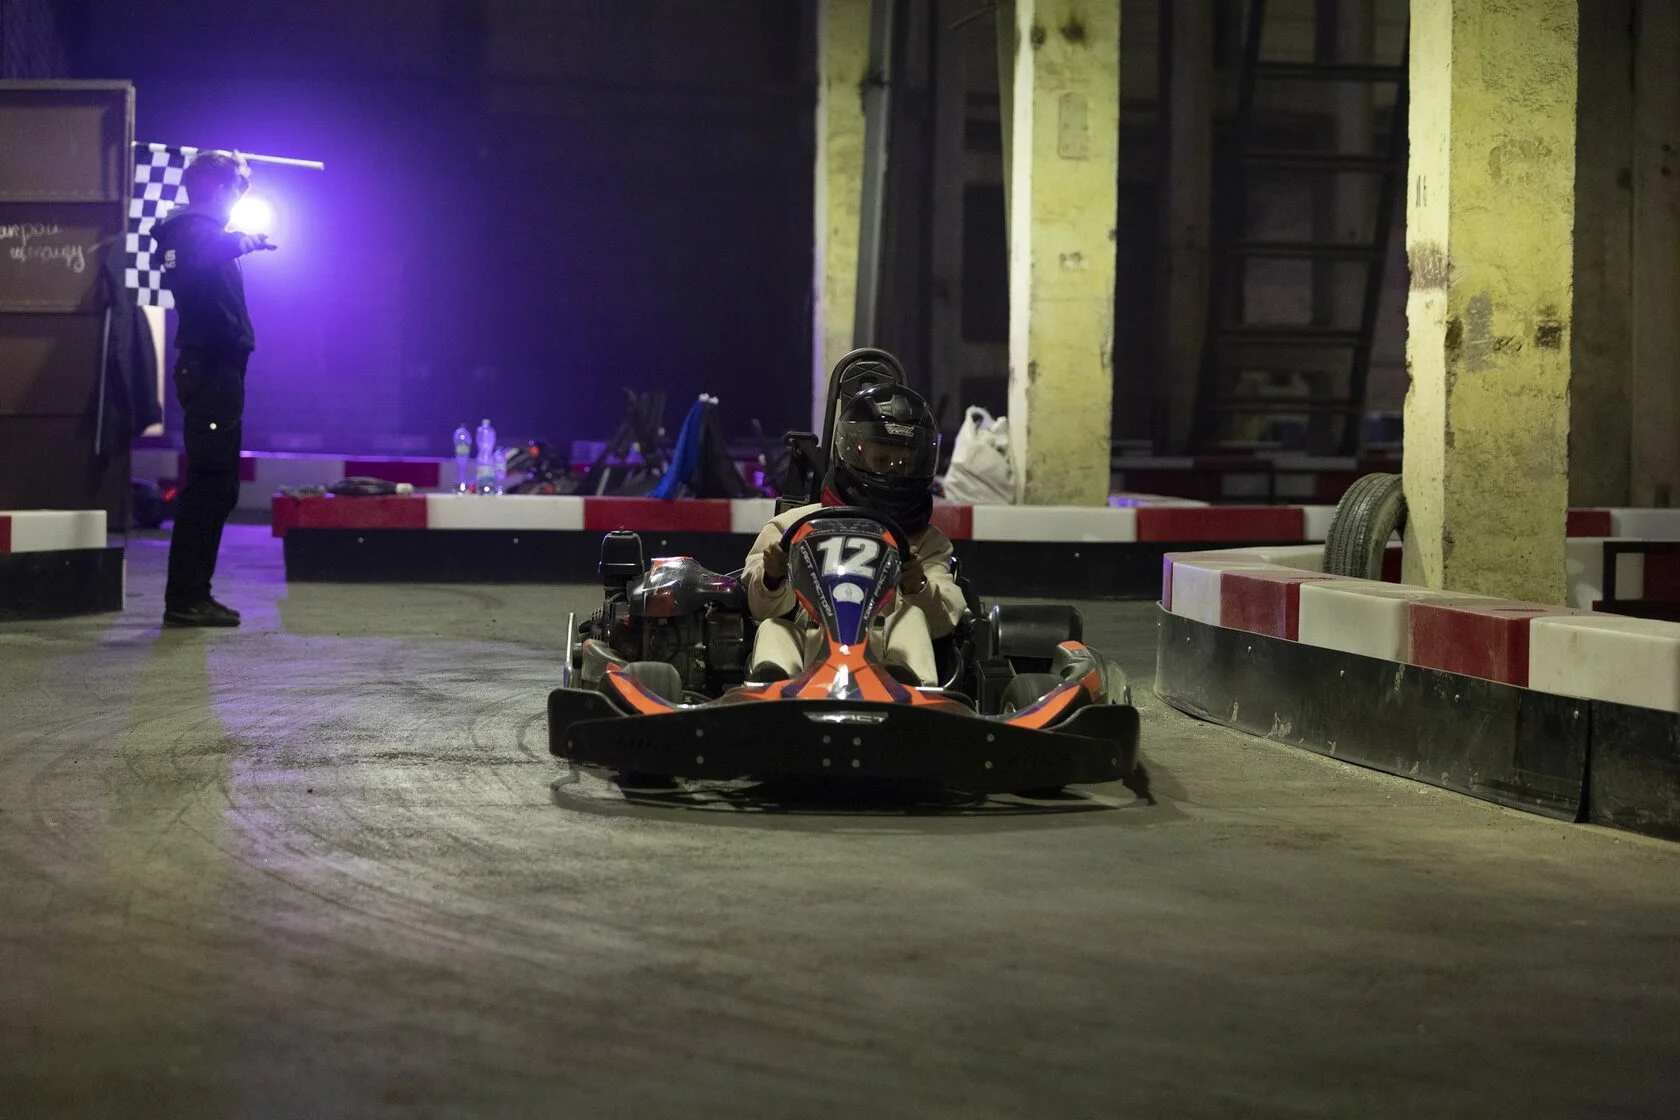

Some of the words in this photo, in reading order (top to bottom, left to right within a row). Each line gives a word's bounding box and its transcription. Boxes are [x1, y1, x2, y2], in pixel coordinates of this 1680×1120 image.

[800, 544, 813, 570] KART
[809, 571, 834, 617] FACTORY
[816, 535, 880, 579] 12
